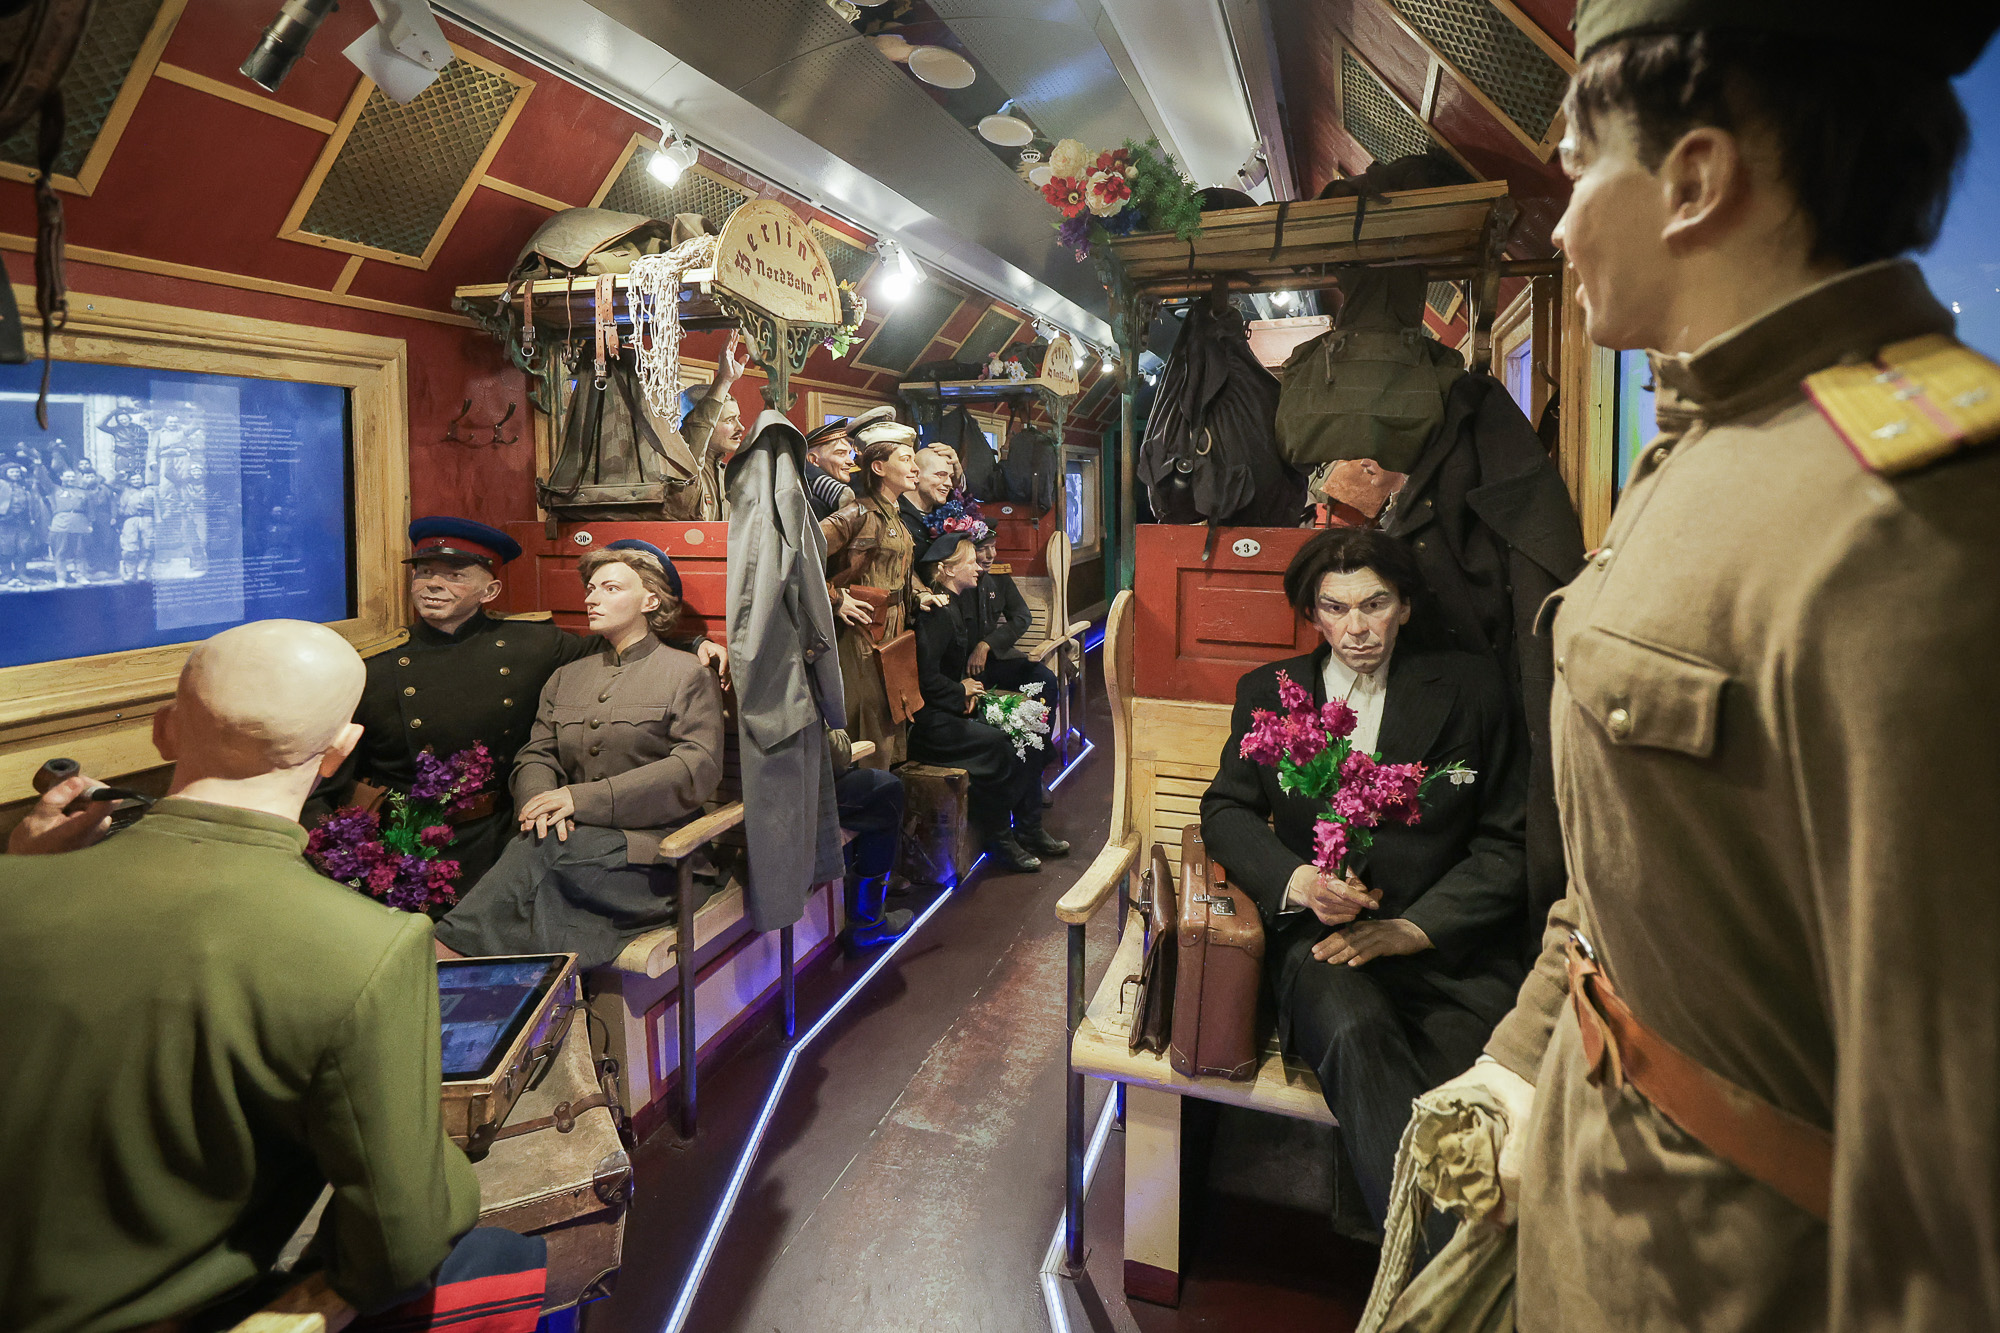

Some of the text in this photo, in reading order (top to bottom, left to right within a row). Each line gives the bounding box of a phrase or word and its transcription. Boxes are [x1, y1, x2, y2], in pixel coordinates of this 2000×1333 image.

[735, 221, 828, 302] Berliner
[578, 534, 587, 543] 30
[1243, 543, 1250, 553] 3
